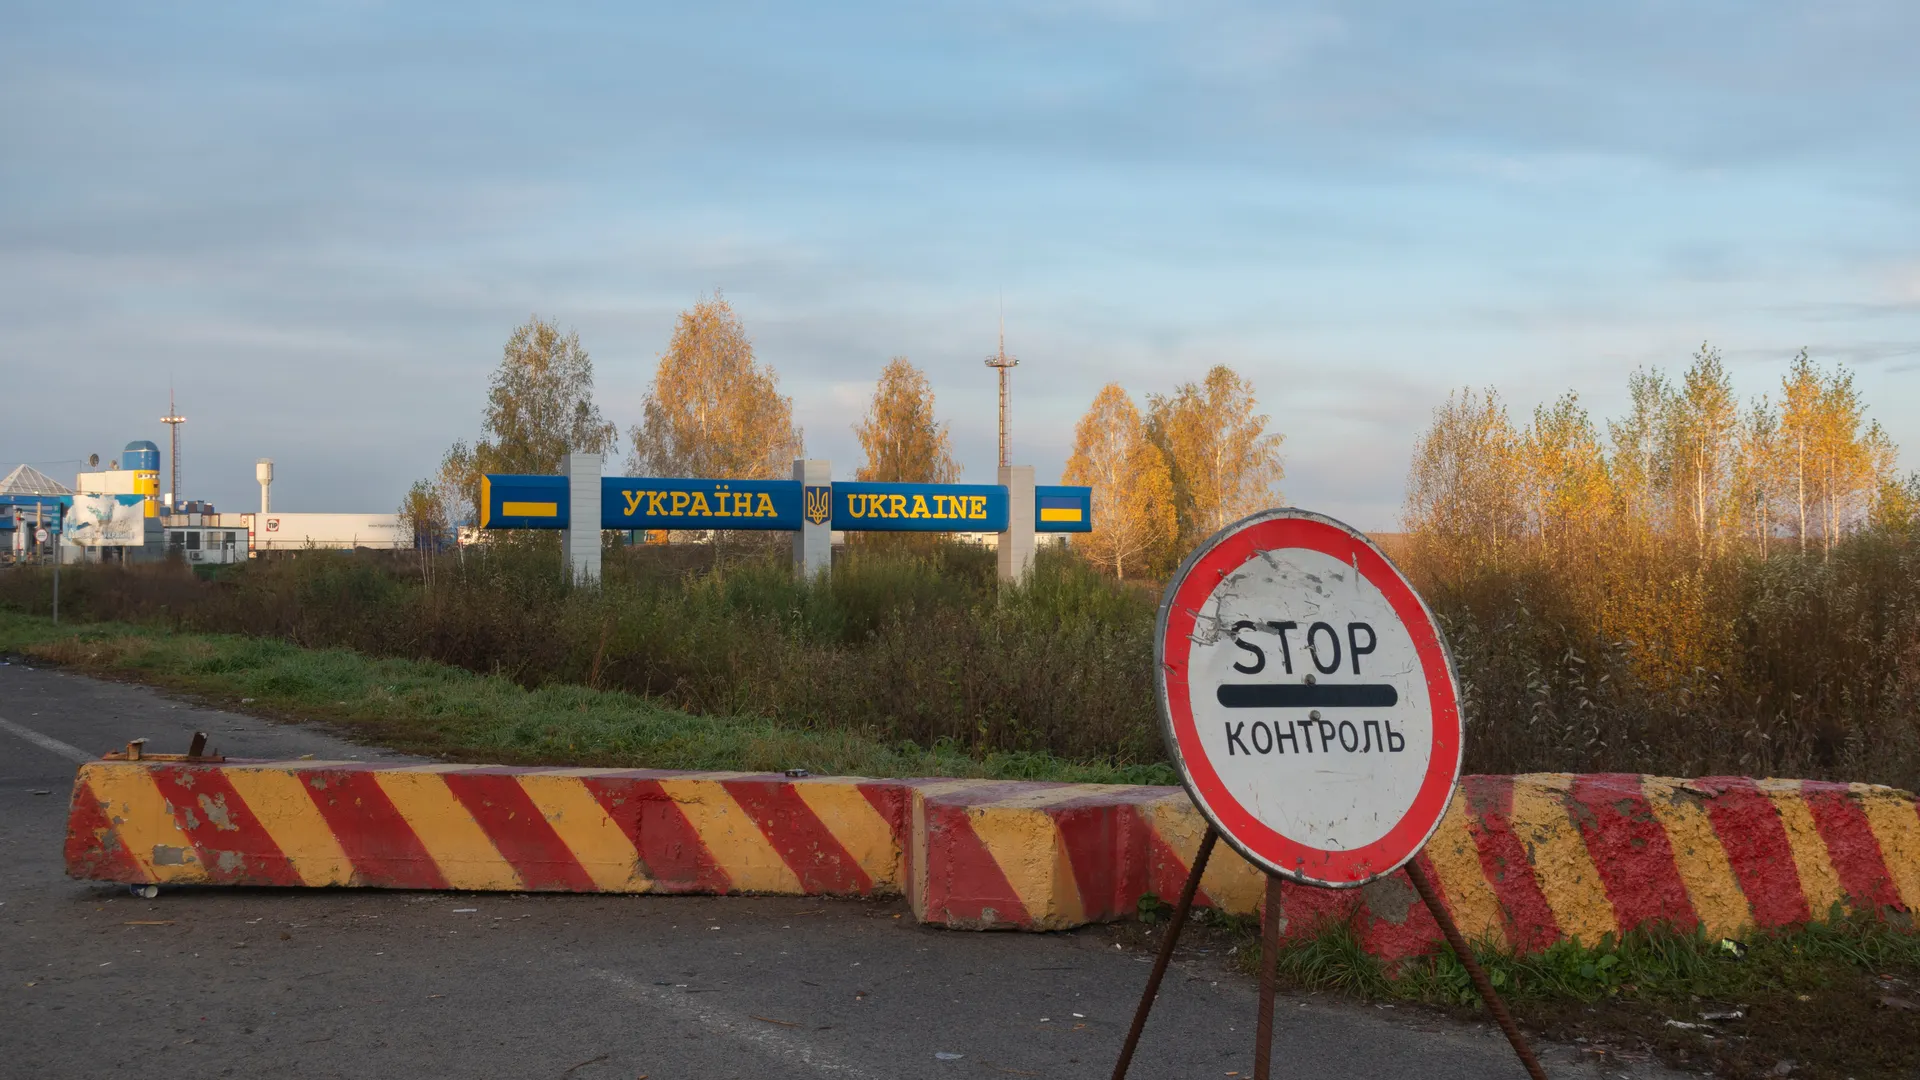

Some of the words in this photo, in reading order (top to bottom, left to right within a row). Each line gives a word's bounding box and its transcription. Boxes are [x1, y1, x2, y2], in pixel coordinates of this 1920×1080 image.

[622, 485, 778, 518] УКРАЇНА
[847, 494, 987, 519] UKRAINE
[1231, 620, 1377, 675] STOP
[1225, 719, 1406, 756] КОНТРОЛЬ
